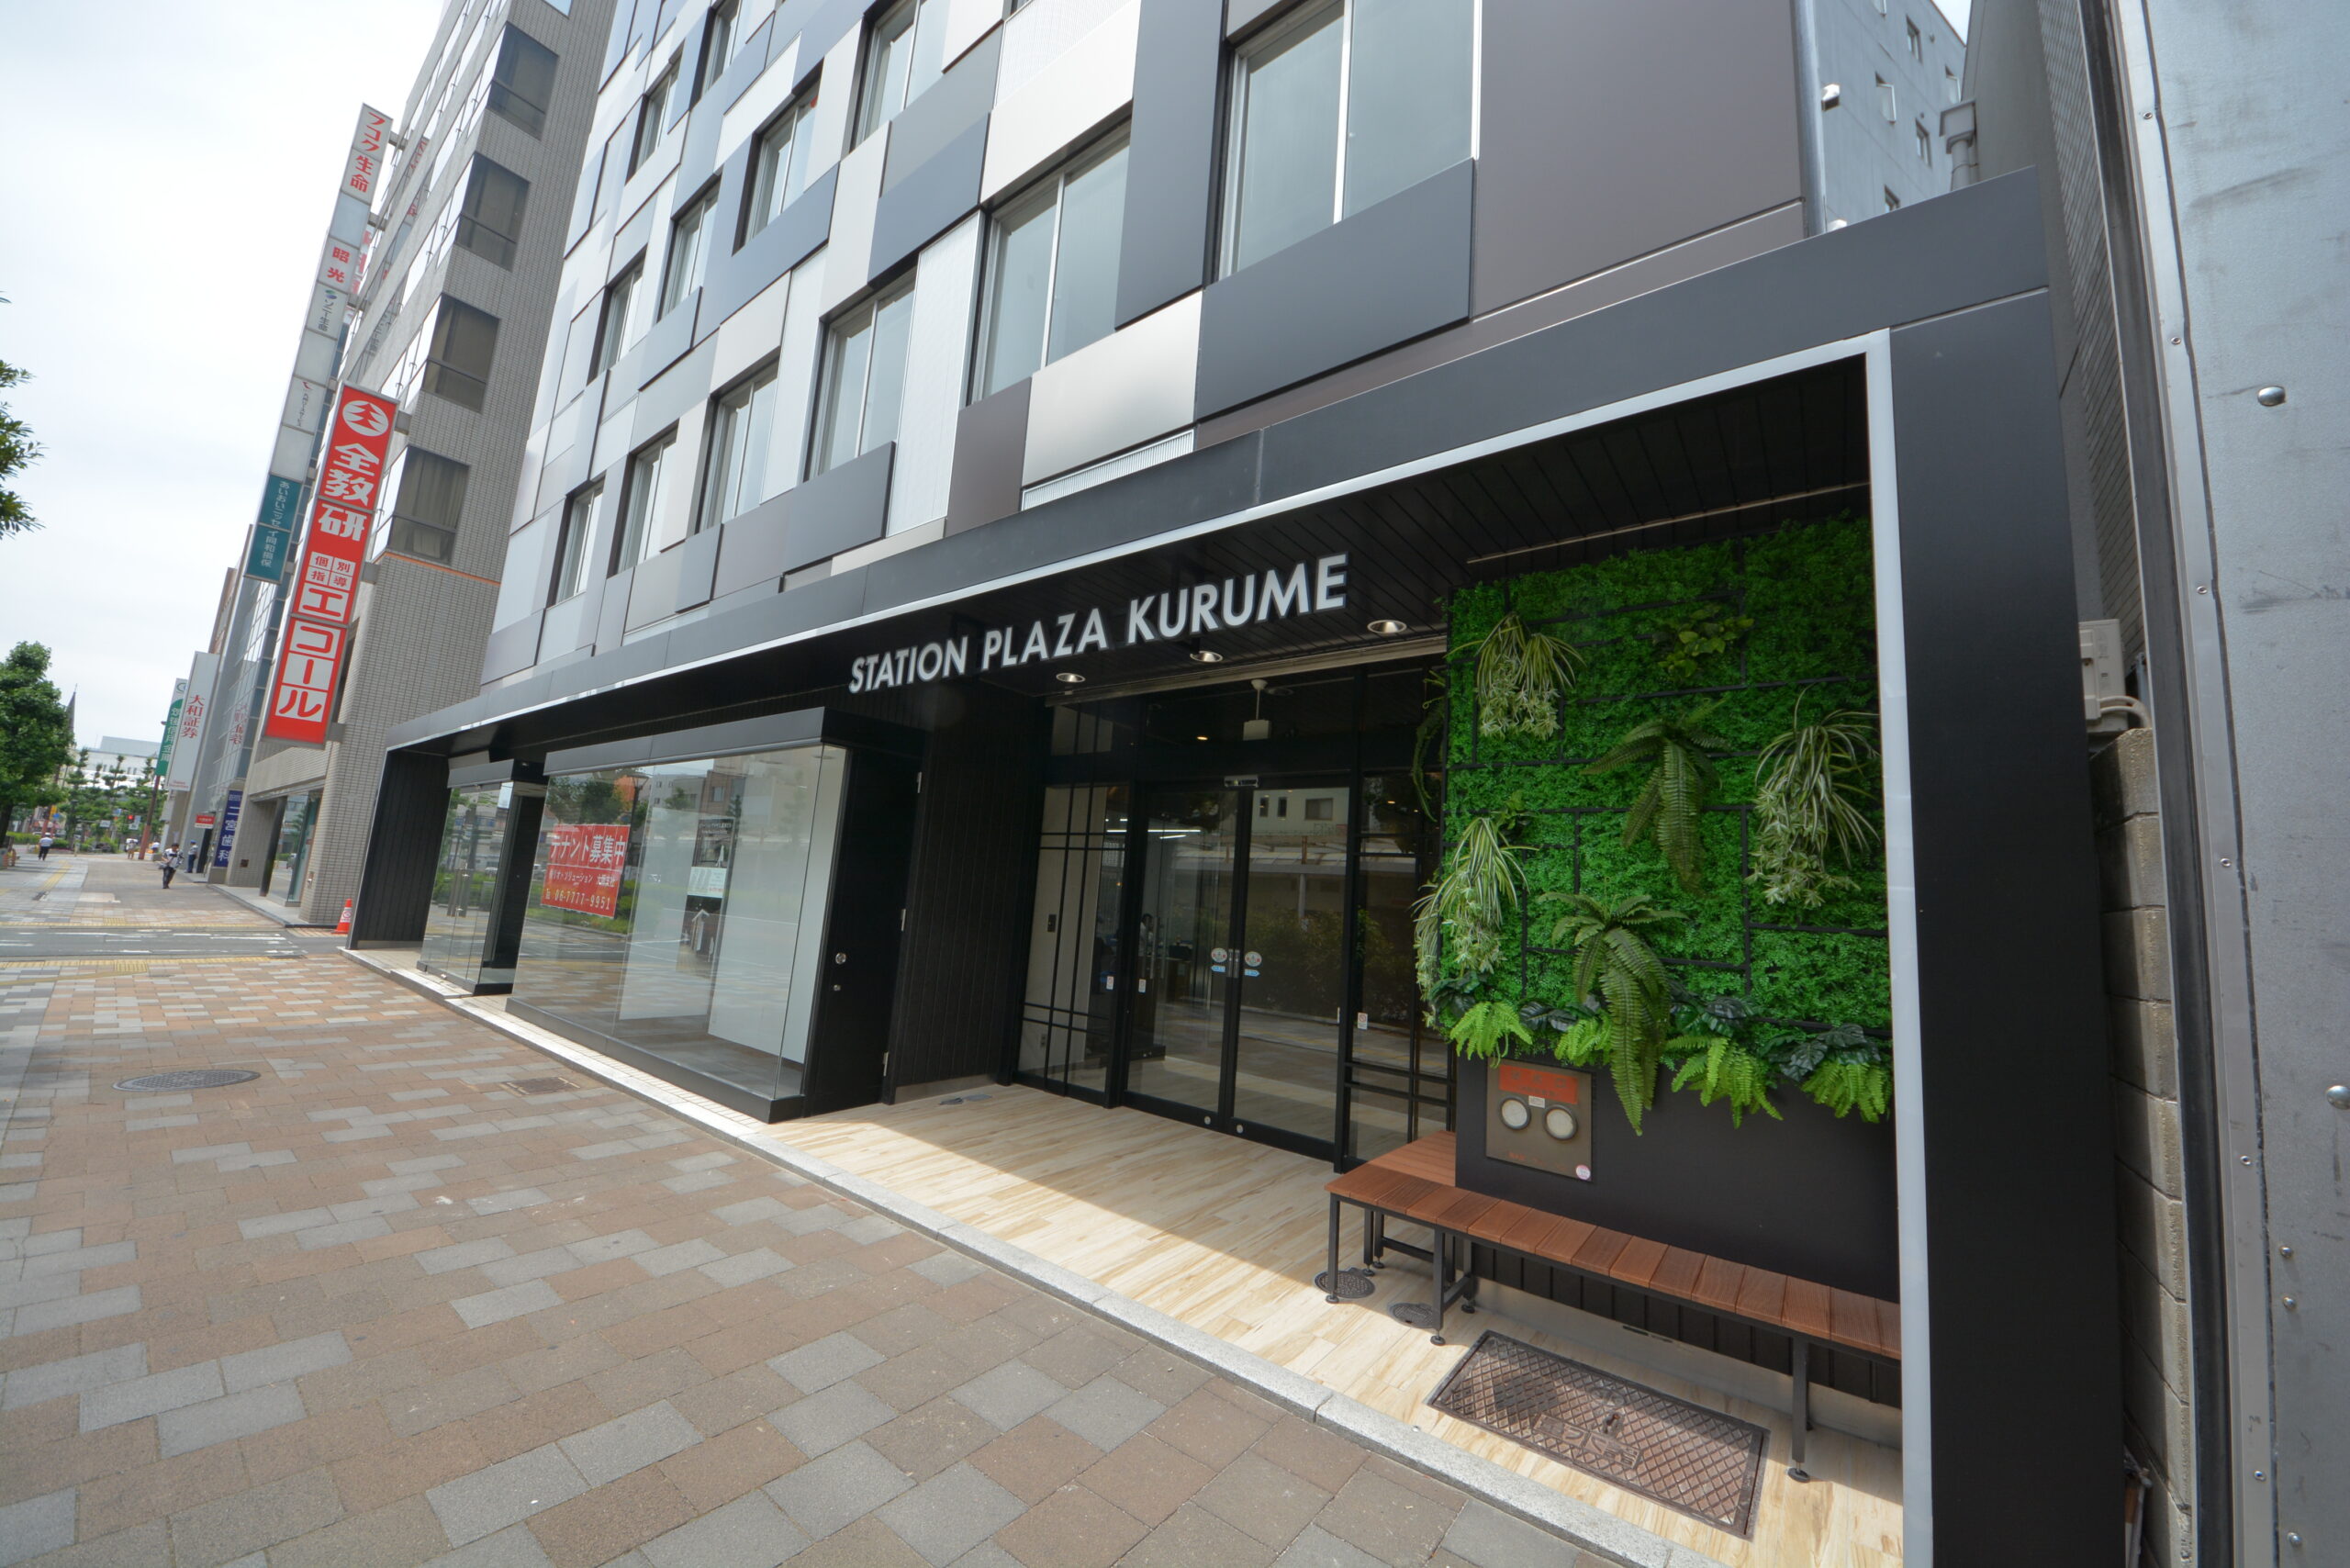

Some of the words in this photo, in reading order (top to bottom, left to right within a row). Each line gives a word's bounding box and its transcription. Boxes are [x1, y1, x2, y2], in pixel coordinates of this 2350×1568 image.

[350, 111, 386, 194] フコク生命
[327, 246, 351, 284] 昭光
[318, 442, 380, 542] 全教研
[310, 568, 348, 588] 指導
[315, 555, 351, 574] 個別
[848, 635, 968, 694] STATION
[981, 607, 1109, 671] PLAZA
[1125, 553, 1348, 644] KURUME
[278, 587, 344, 718] エコール
[181, 694, 206, 739] 大和証券
[550, 834, 626, 866] テナント募集中
[554, 888, 610, 911] 06-7777-9951
